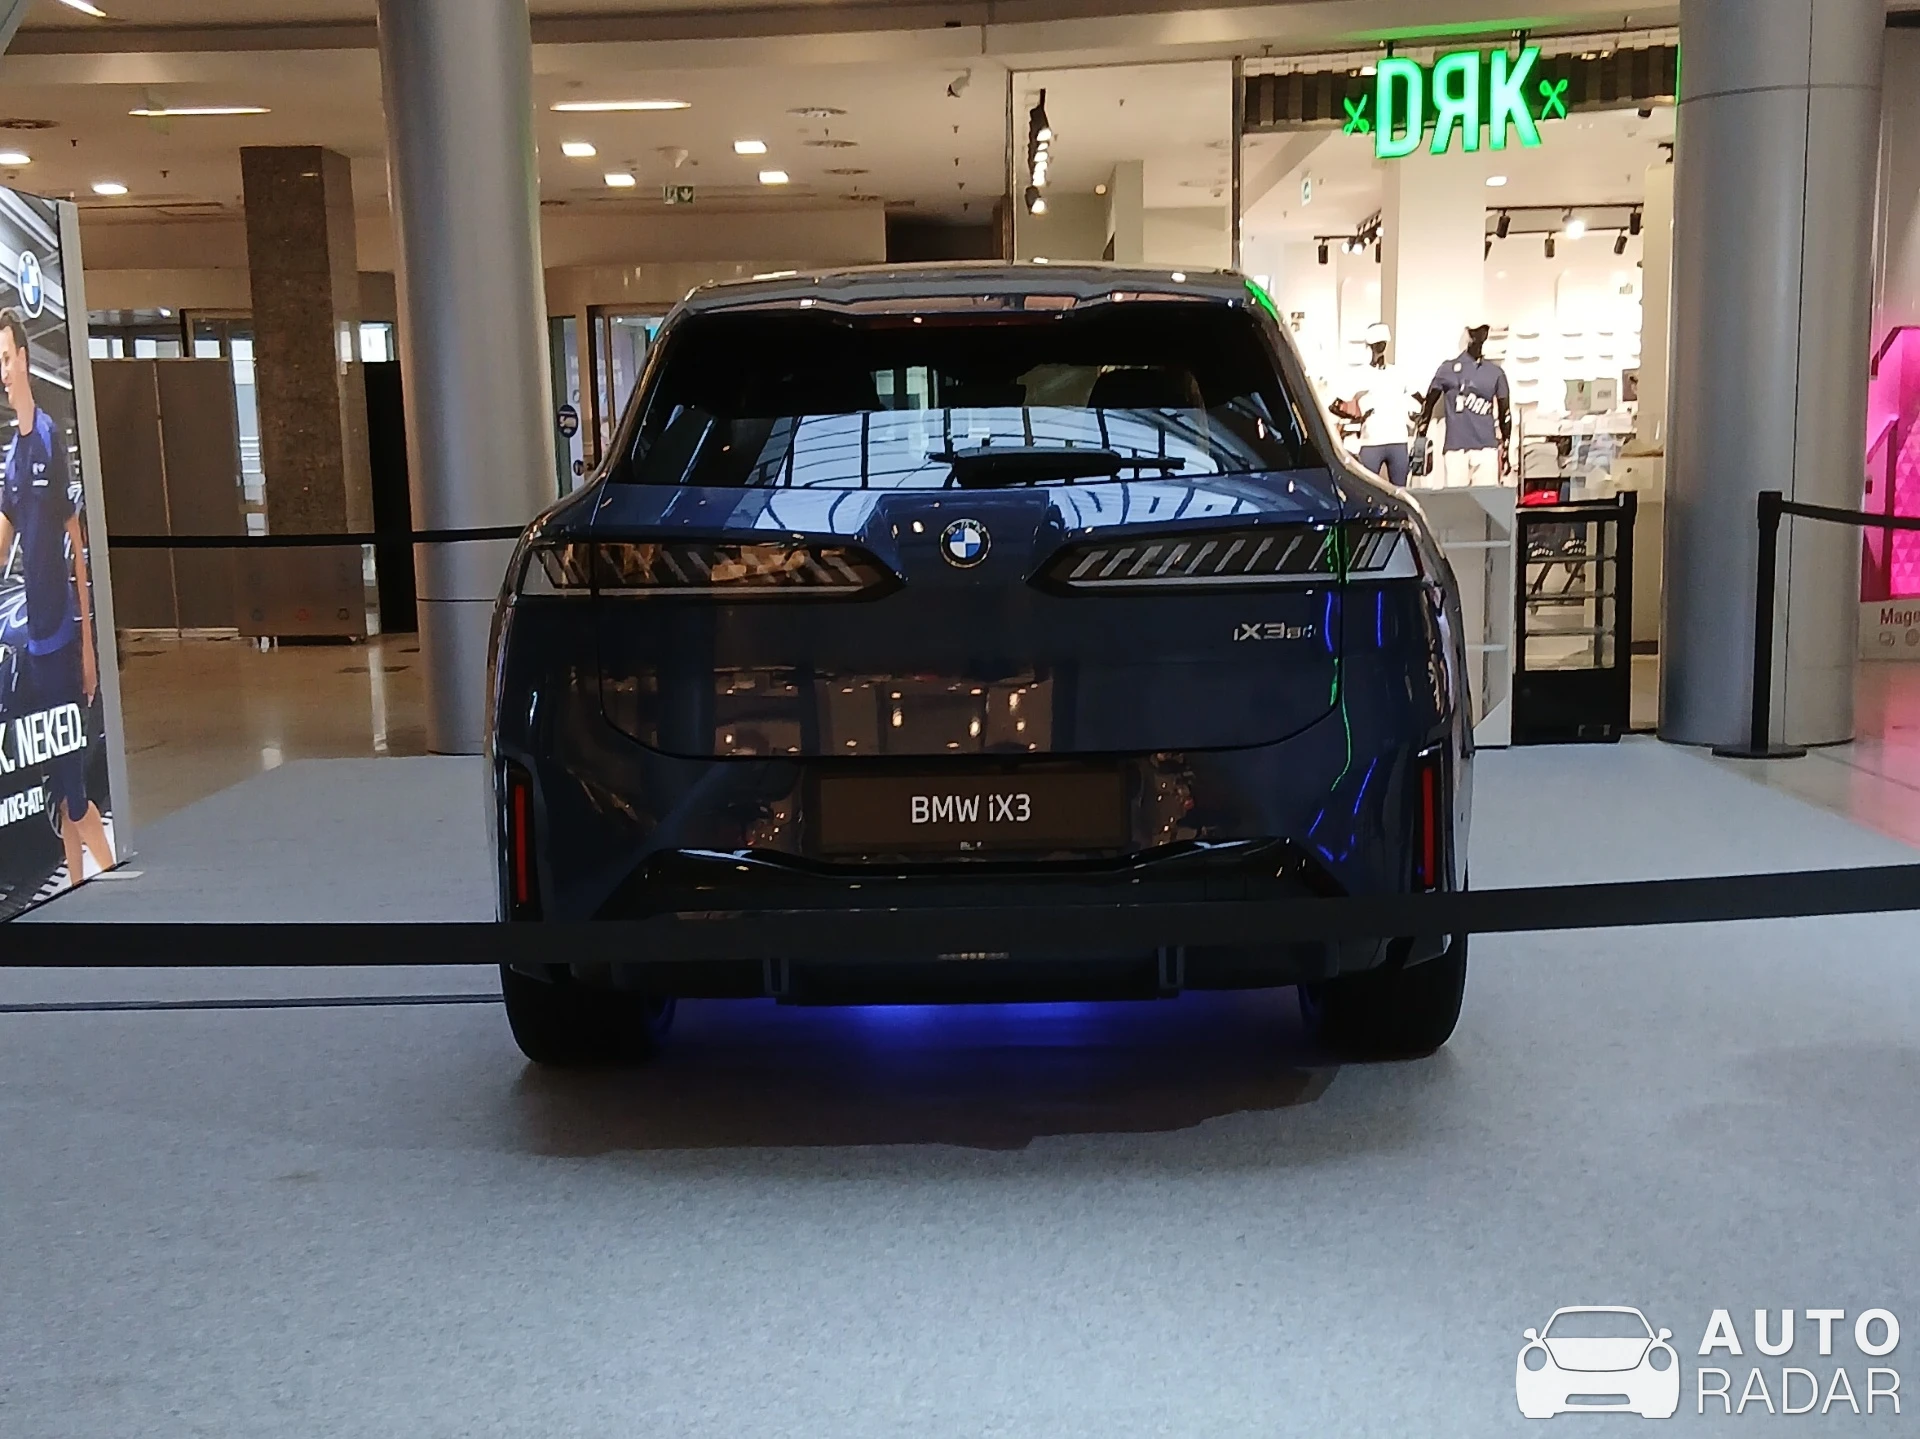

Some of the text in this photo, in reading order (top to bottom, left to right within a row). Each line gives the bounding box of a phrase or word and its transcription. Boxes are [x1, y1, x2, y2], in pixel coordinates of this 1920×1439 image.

[15, 702, 87, 768] NEKED.
[911, 793, 1031, 824] BMW iX3
